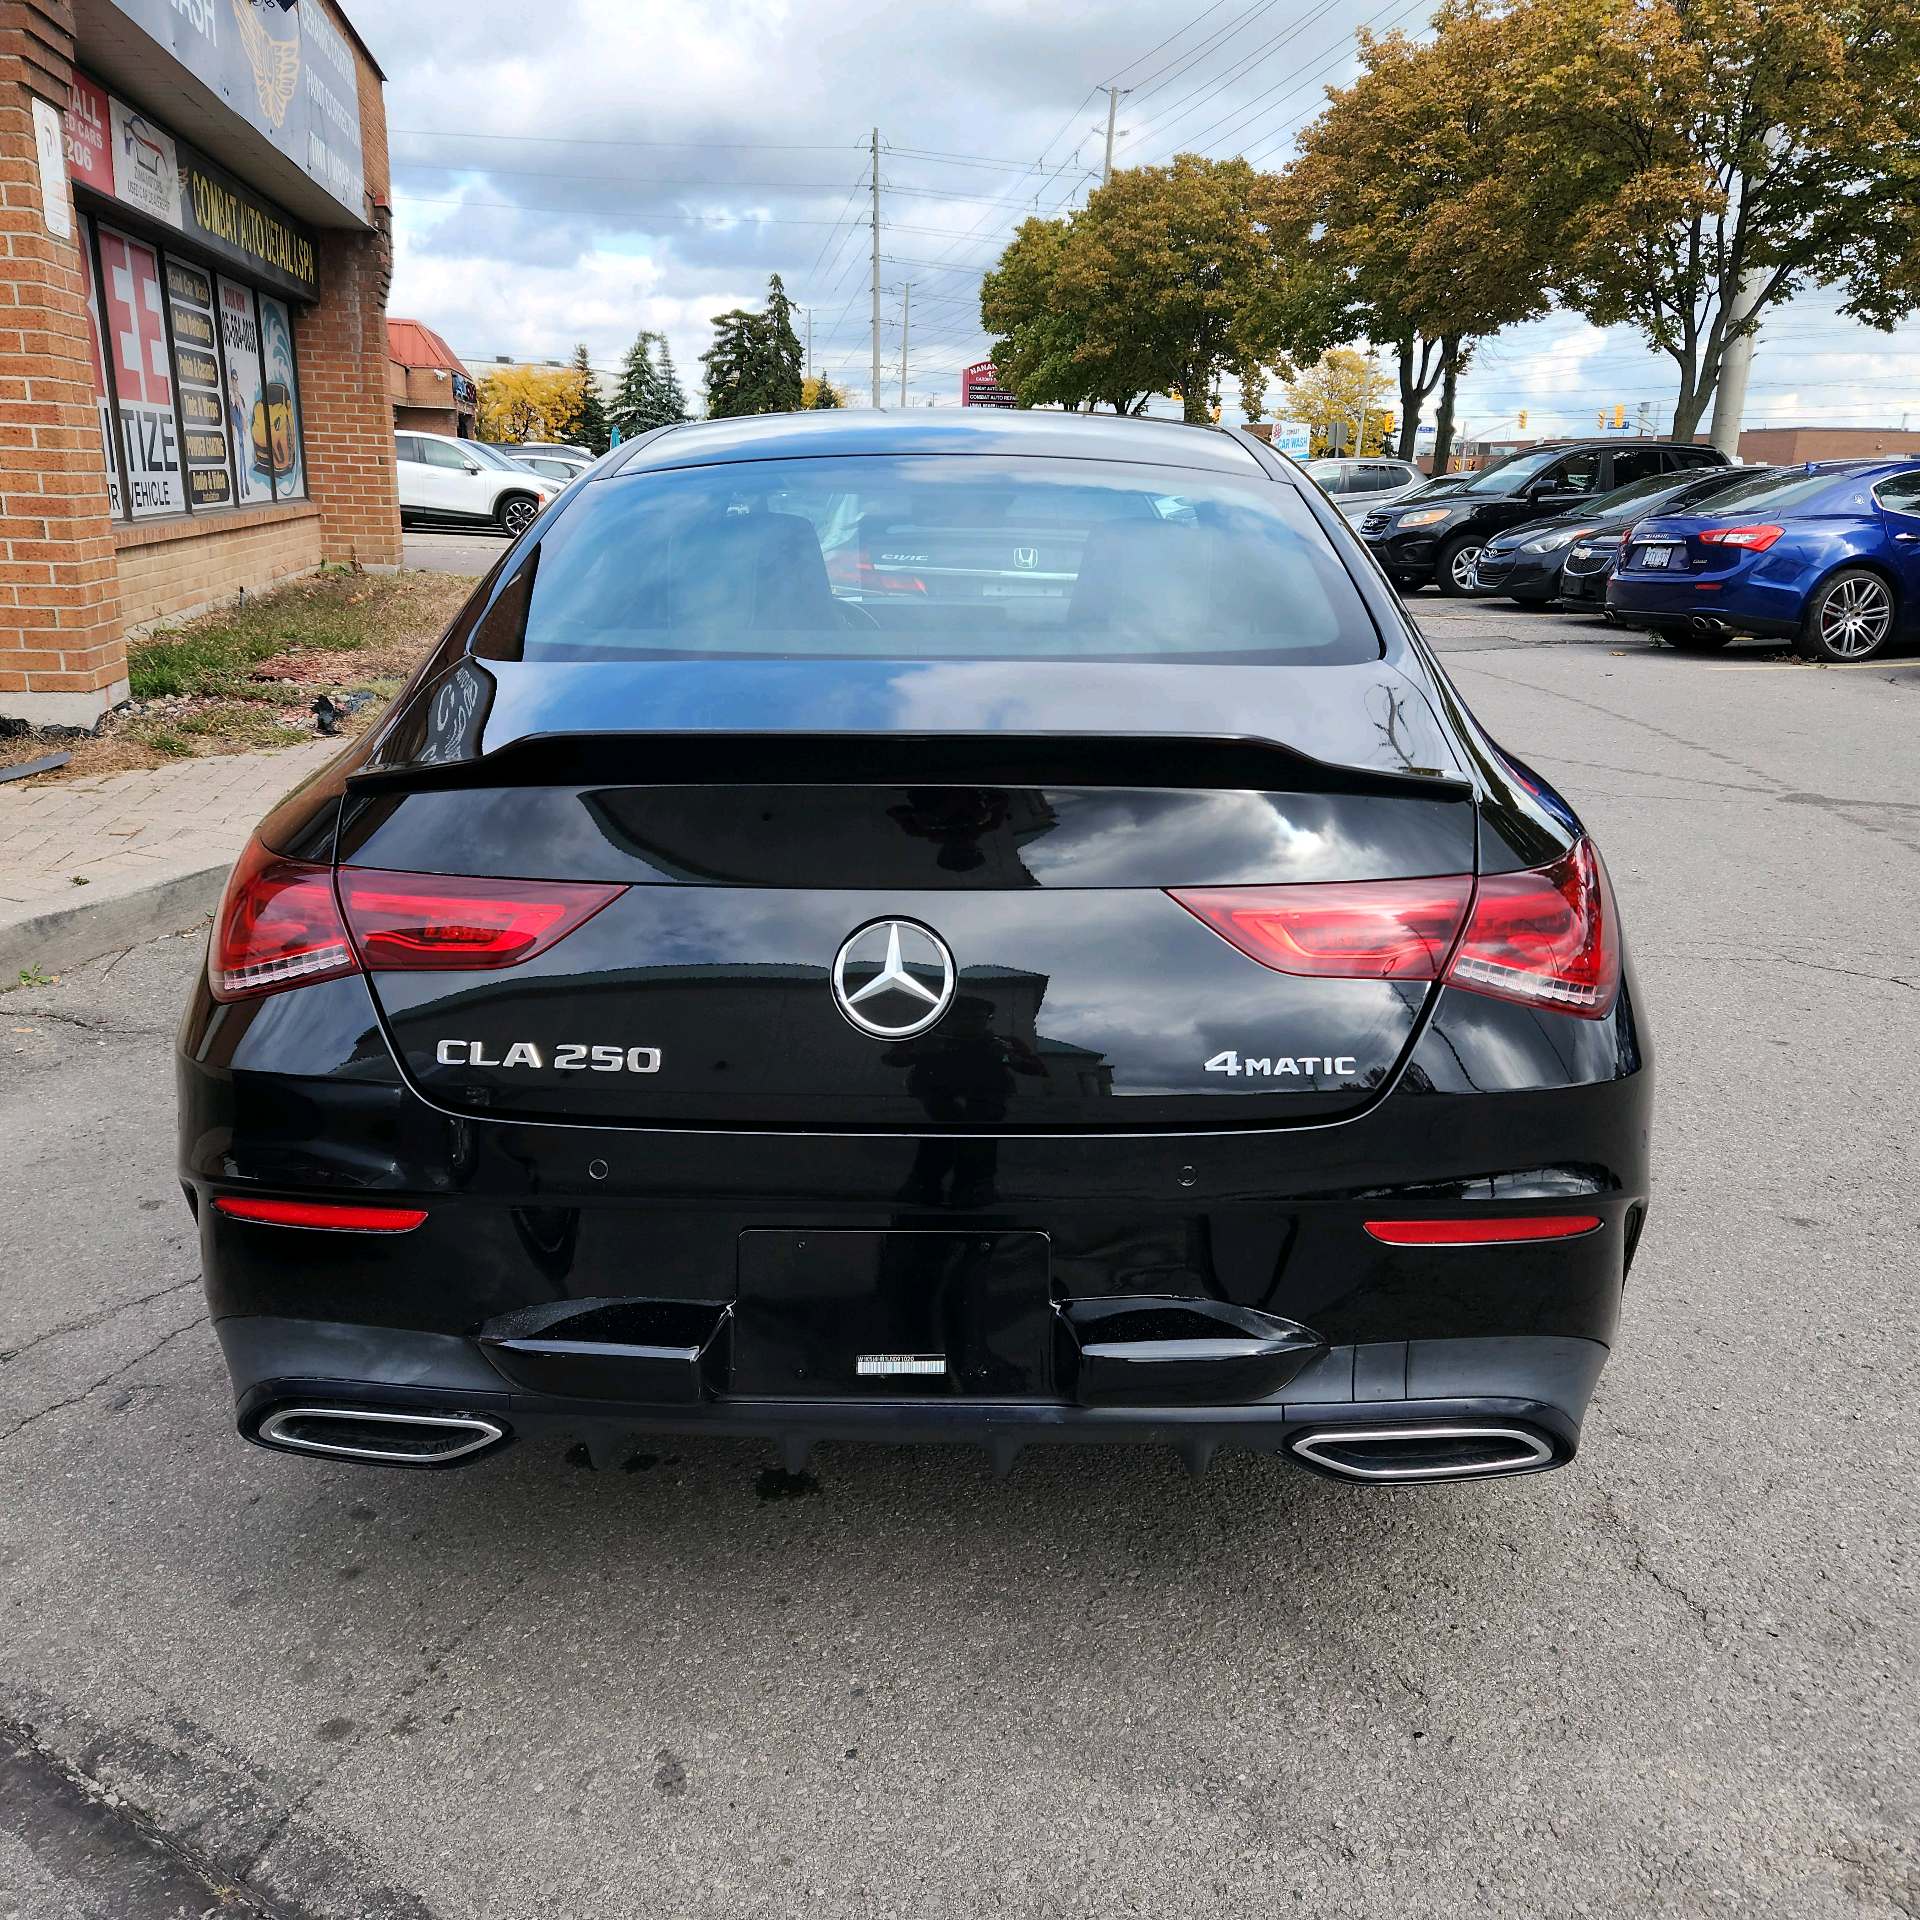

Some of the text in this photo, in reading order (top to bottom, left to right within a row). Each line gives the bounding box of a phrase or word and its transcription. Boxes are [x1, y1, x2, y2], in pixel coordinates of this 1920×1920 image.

[77, 120, 102, 150] CARS
[193, 170, 238, 246] COMBAT
[240, 200, 265, 259] AUTO
[265, 215, 294, 275] DETAIL
[298, 237, 314, 285] SPA
[1291, 437, 1308, 449] WASH
[437, 1040, 661, 1073] CLA 250
[1204, 1051, 1356, 1076] 4MATIC
